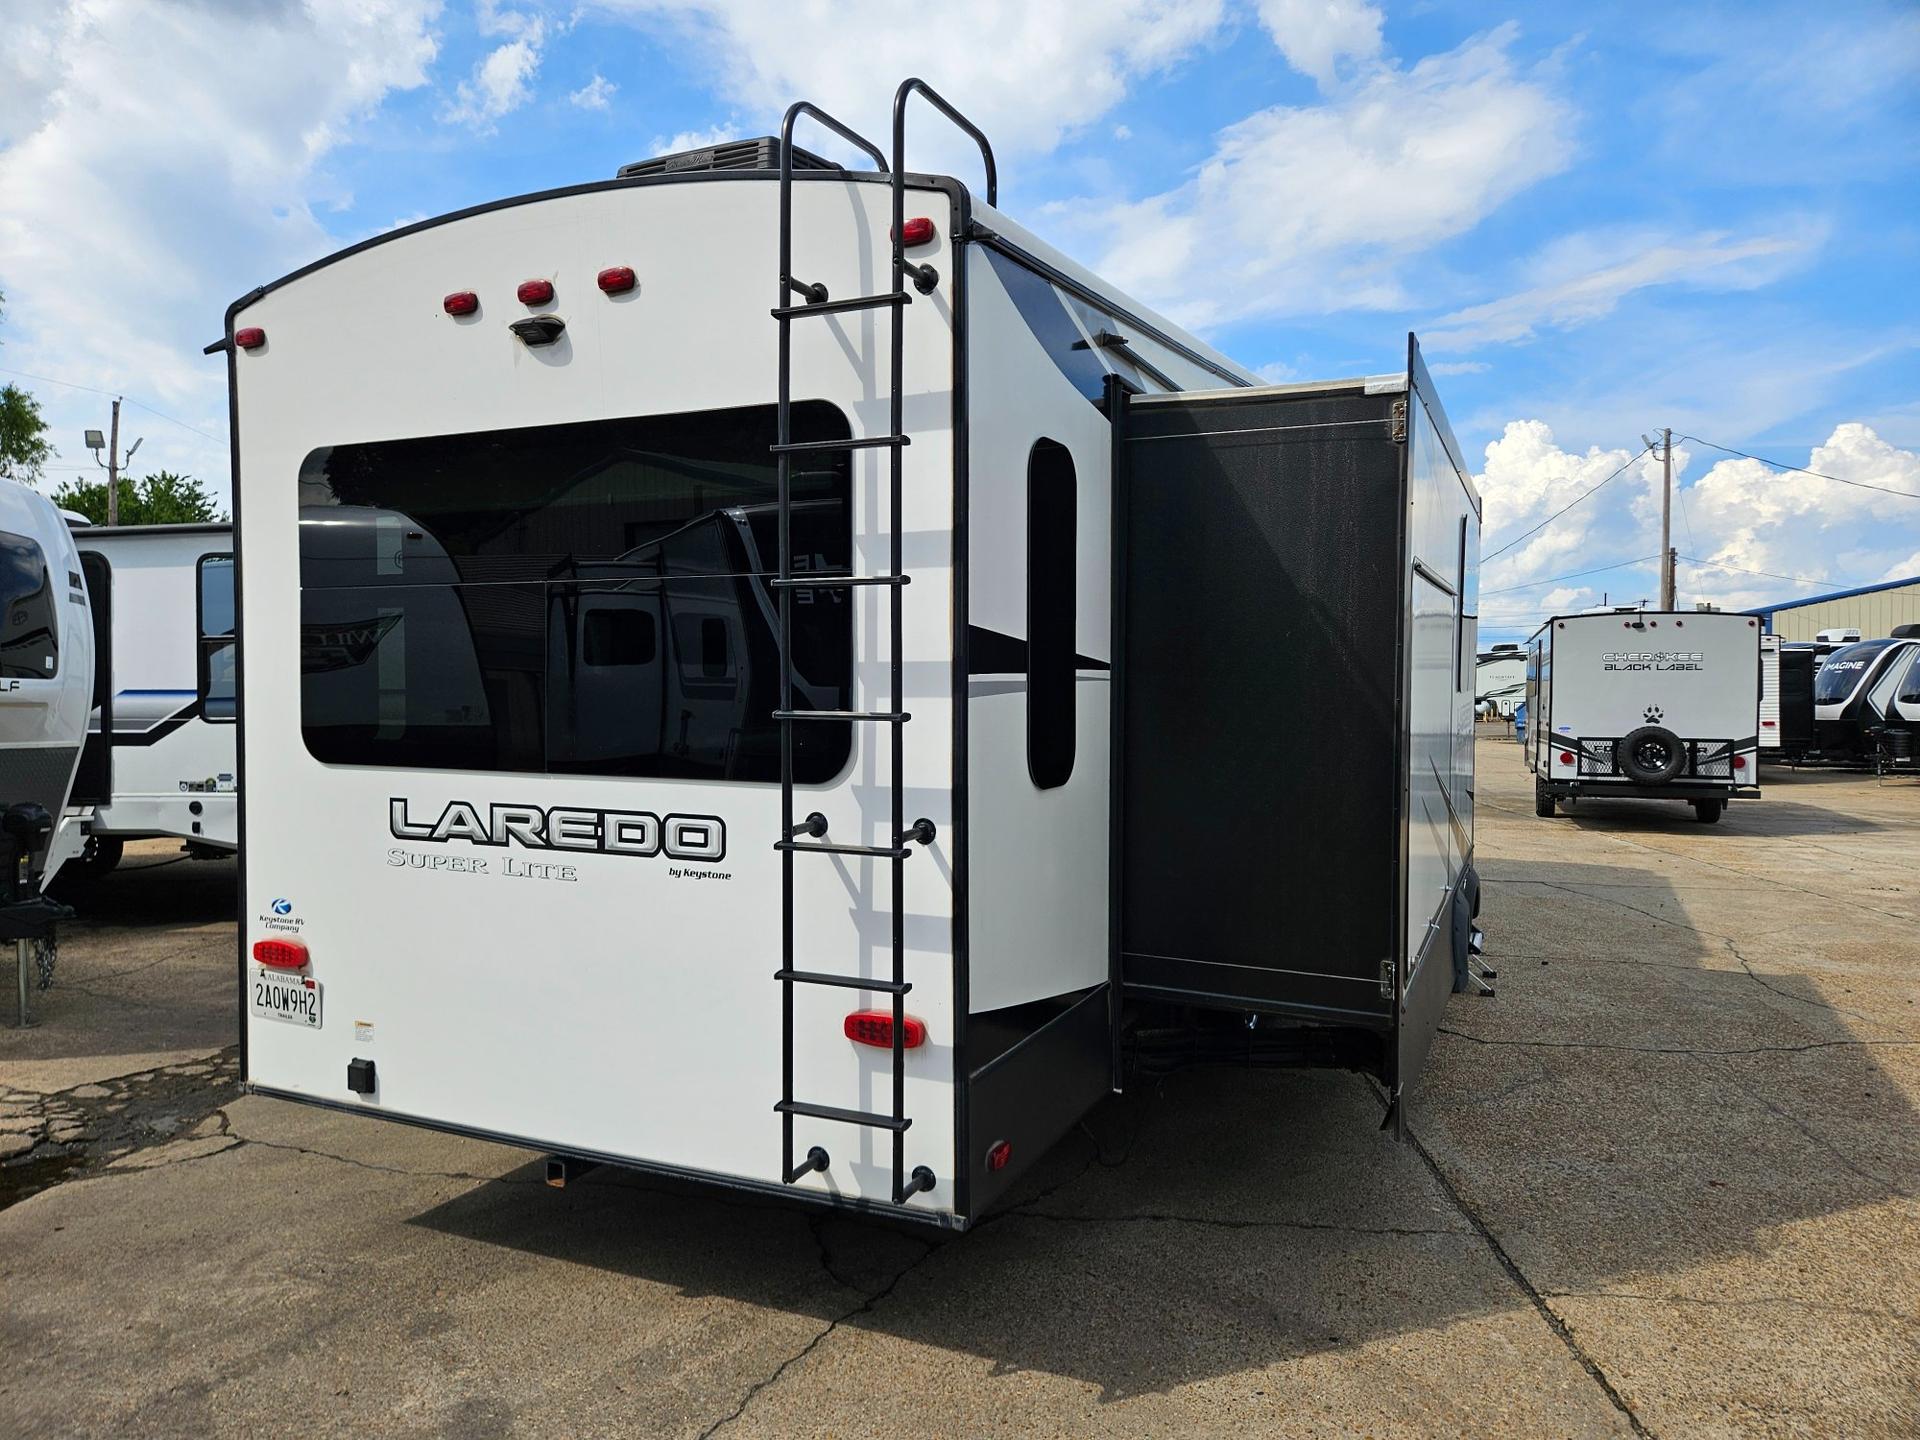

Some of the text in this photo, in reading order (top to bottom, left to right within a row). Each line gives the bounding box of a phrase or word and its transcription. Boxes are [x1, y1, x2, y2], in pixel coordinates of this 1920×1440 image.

[1602, 652, 1704, 662] CHEROKEE
[1604, 663, 1704, 671] BLACK LABEL
[1824, 661, 1865, 671] IMAGINE
[389, 797, 727, 863] LAREDO
[386, 847, 578, 882] SUPER LITE
[669, 867, 732, 880] by Keystone
[259, 915, 304, 926] Keystone RV
[265, 922, 300, 933] Company
[267, 973, 302, 985] ALABAMA
